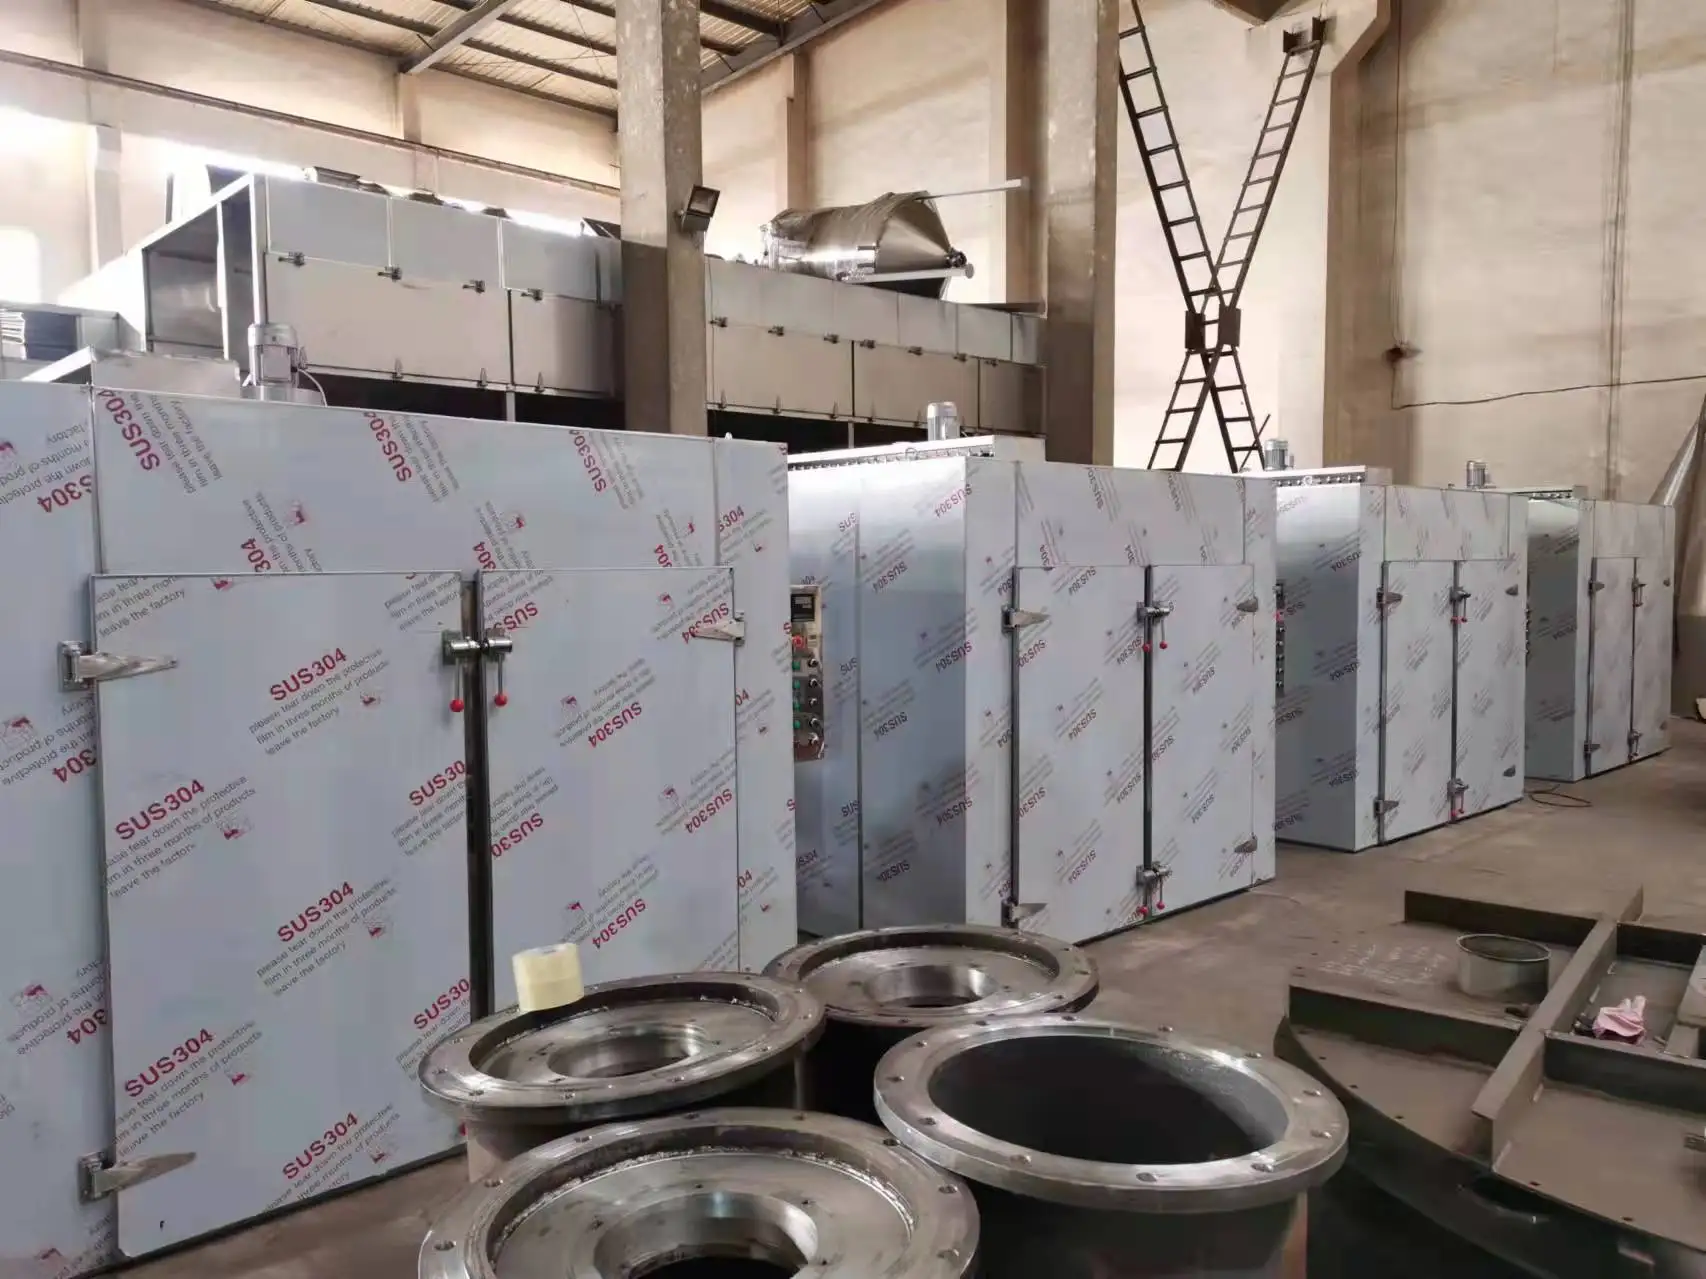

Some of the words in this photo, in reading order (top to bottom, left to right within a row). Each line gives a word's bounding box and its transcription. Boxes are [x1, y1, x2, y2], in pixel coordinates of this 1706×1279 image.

[99, 617, 128, 636] leave
[129, 607, 147, 620] the
[147, 588, 184, 610] factory
[268, 646, 346, 701] SUS304
[935, 641, 973, 672] SUS304
[300, 683, 325, 701] down
[256, 730, 274, 744] film
[588, 701, 642, 748] SUS304
[114, 777, 204, 840] SUS304
[128, 836, 150, 852] tear
[151, 818, 180, 838] down
[200, 776, 247, 810] protective
[133, 846, 162, 866] three
[163, 822, 200, 848] months
[214, 788, 255, 818] products
[685, 787, 733, 834] SUS304
[141, 866, 158, 879] the
[276, 881, 353, 942] SUS304
[292, 946, 316, 966] three
[317, 922, 349, 948] months
[361, 888, 396, 917] products
[592, 897, 646, 949] SUS304
[256, 952, 287, 978] please
[288, 938, 307, 953] tear
[307, 919, 332, 938] down
[332, 908, 347, 920] the
[123, 1027, 212, 1097] SUS304
[137, 1091, 159, 1108] tear
[159, 1069, 188, 1091] down
[149, 1119, 167, 1133] the
[281, 1112, 357, 1179] SUS304
